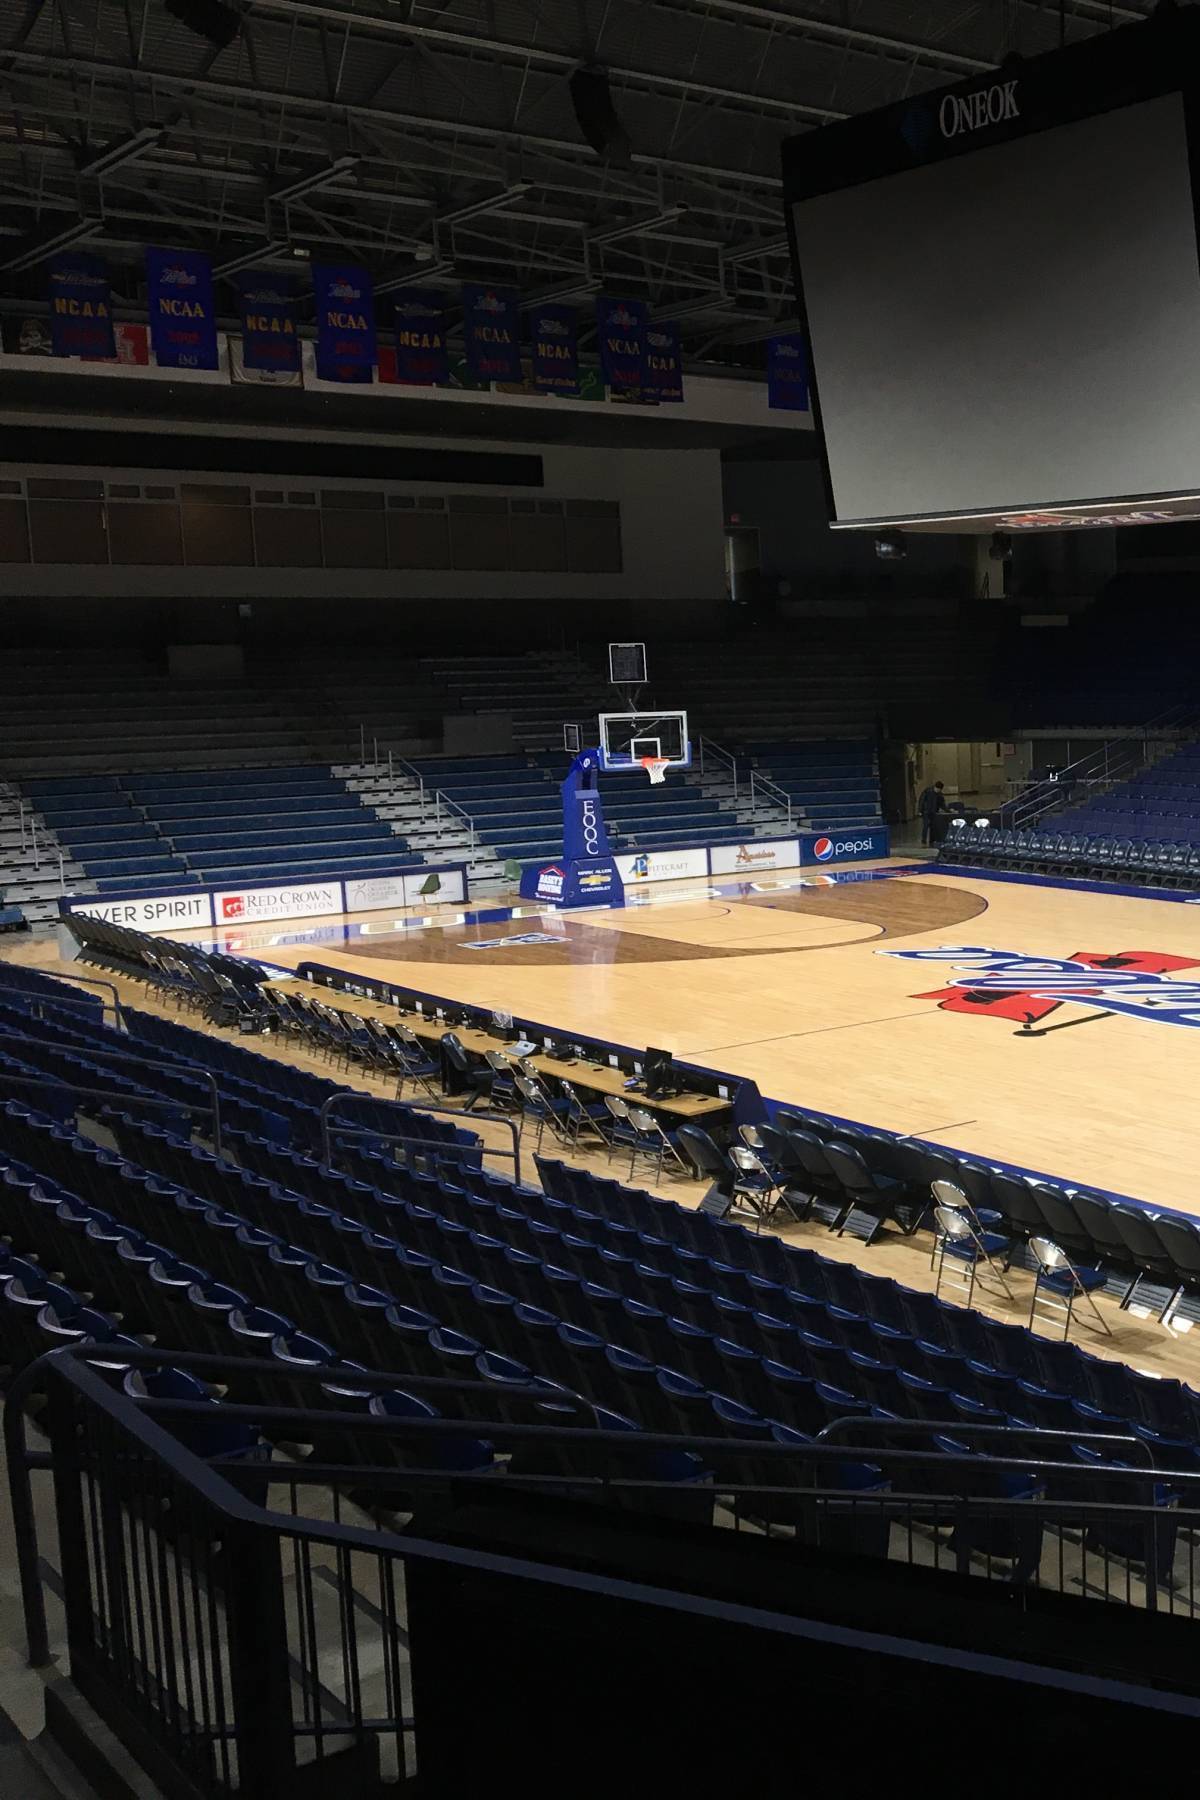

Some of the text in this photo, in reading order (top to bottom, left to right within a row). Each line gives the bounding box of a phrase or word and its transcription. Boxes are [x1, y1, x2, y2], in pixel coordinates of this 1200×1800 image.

[938, 79, 1021, 140] ONEOK
[54, 298, 107, 318] NCAA
[160, 300, 204, 319] NCAA
[246, 314, 294, 335] NCAA
[327, 312, 368, 330] NCAA
[400, 330, 441, 349] NCAA
[473, 328, 513, 344] NCAA
[537, 343, 571, 359] NCAA
[607, 338, 640, 355] NCAA
[583, 800, 598, 854] EOOC
[835, 837, 874, 856] pepsi
[247, 889, 333, 907] RED CROWN
[144, 899, 202, 920] SPIRIT
[246, 901, 334, 916] CREDIT UNION
